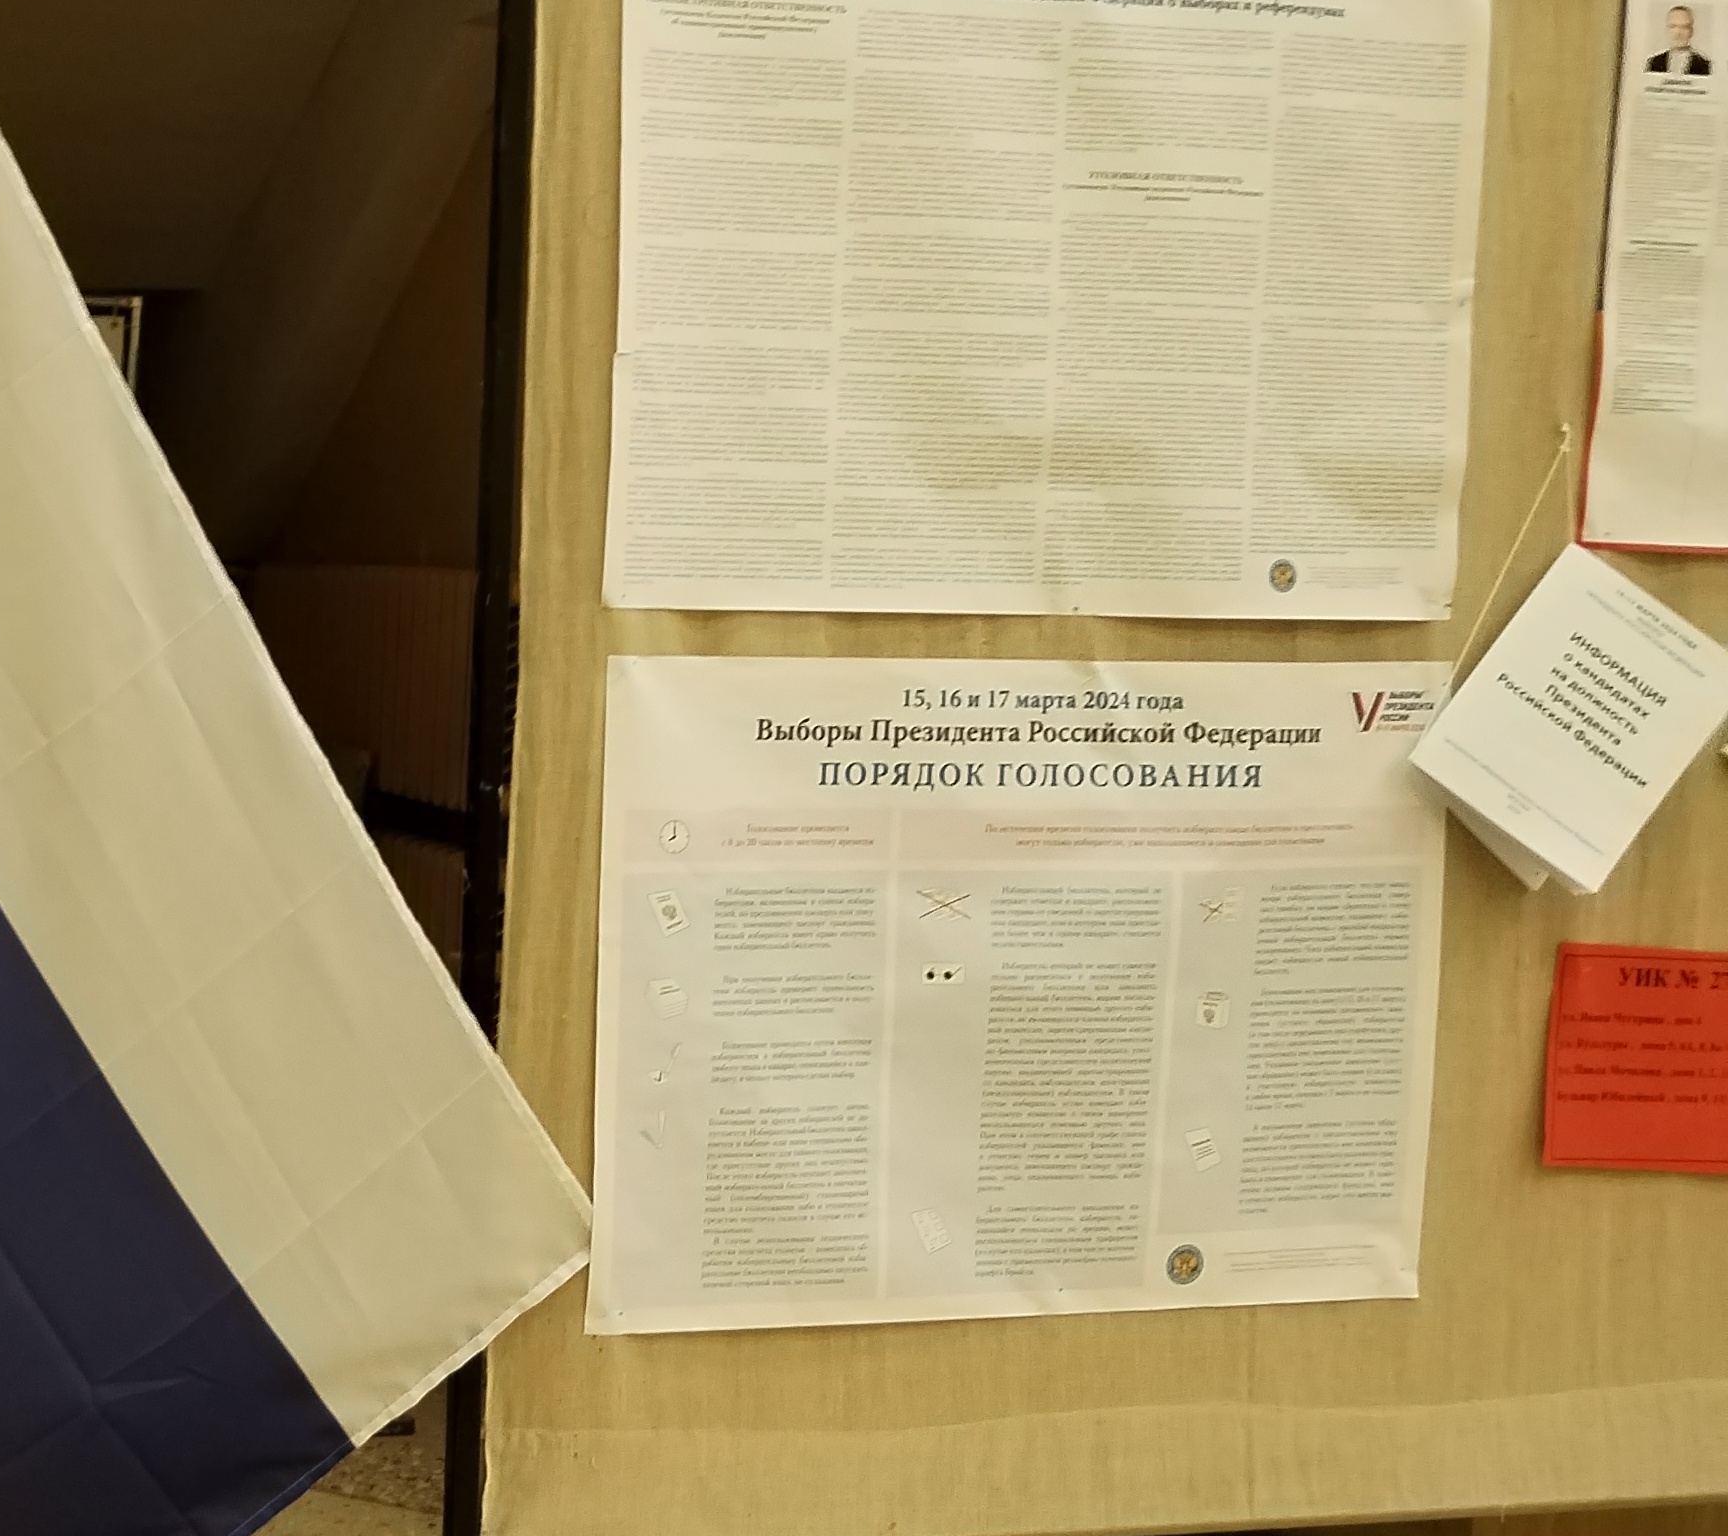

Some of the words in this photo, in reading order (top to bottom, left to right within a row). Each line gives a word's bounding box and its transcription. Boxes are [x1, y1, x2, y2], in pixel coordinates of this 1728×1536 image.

[1563, 652, 1573, 662] о
[1574, 661, 1650, 720] кандидатах
[1569, 631, 1668, 708] ИНФОРМАЦИЯ
[902, 688, 931, 710] 15,
[939, 688, 962, 708] 16
[967, 694, 981, 708] и
[987, 689, 1010, 708] 17
[1014, 693, 1076, 714] марта
[1083, 691, 1131, 710] 2024
[1136, 694, 1184, 713] года
[1496, 672, 1572, 732] Российской
[1573, 729, 1648, 789] Федерации
[1544, 684, 1622, 746] Президента
[1550, 666, 1568, 682] на
[1567, 680, 1639, 736] должность
[755, 716, 863, 749] Выборы
[868, 719, 1021, 749] Президента
[1027, 719, 1176, 744] Российской
[1183, 720, 1322, 750] Федерации
[818, 762, 984, 792] ПОРЯДОК
[996, 762, 1263, 789] ГОЛОСОВАНИЯ
[1618, 967, 1671, 988] УИК
[1674, 969, 1699, 989] №
